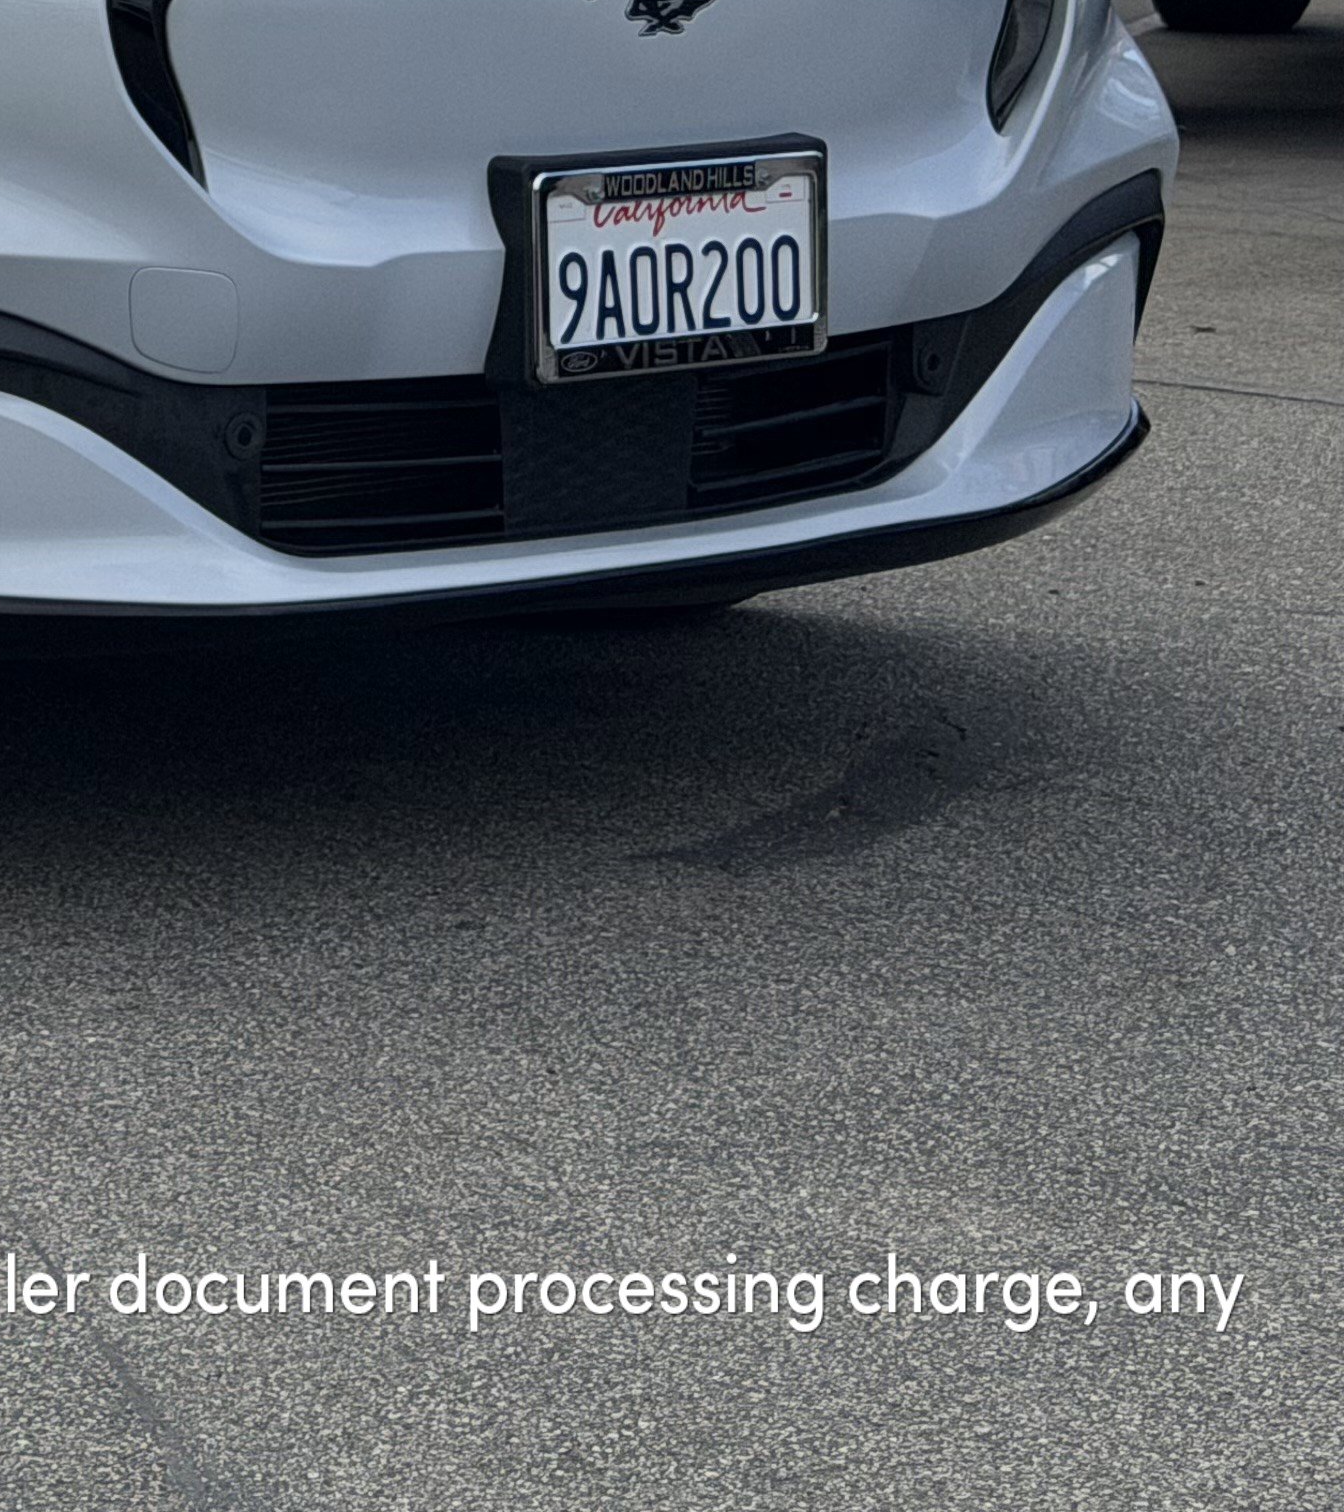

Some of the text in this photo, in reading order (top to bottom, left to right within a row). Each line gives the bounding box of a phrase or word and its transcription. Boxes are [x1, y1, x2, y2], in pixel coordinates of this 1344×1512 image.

[605, 165, 754, 197] WOODLAND HILLS
[593, 191, 766, 237] California
[615, 335, 728, 370] VISTA
